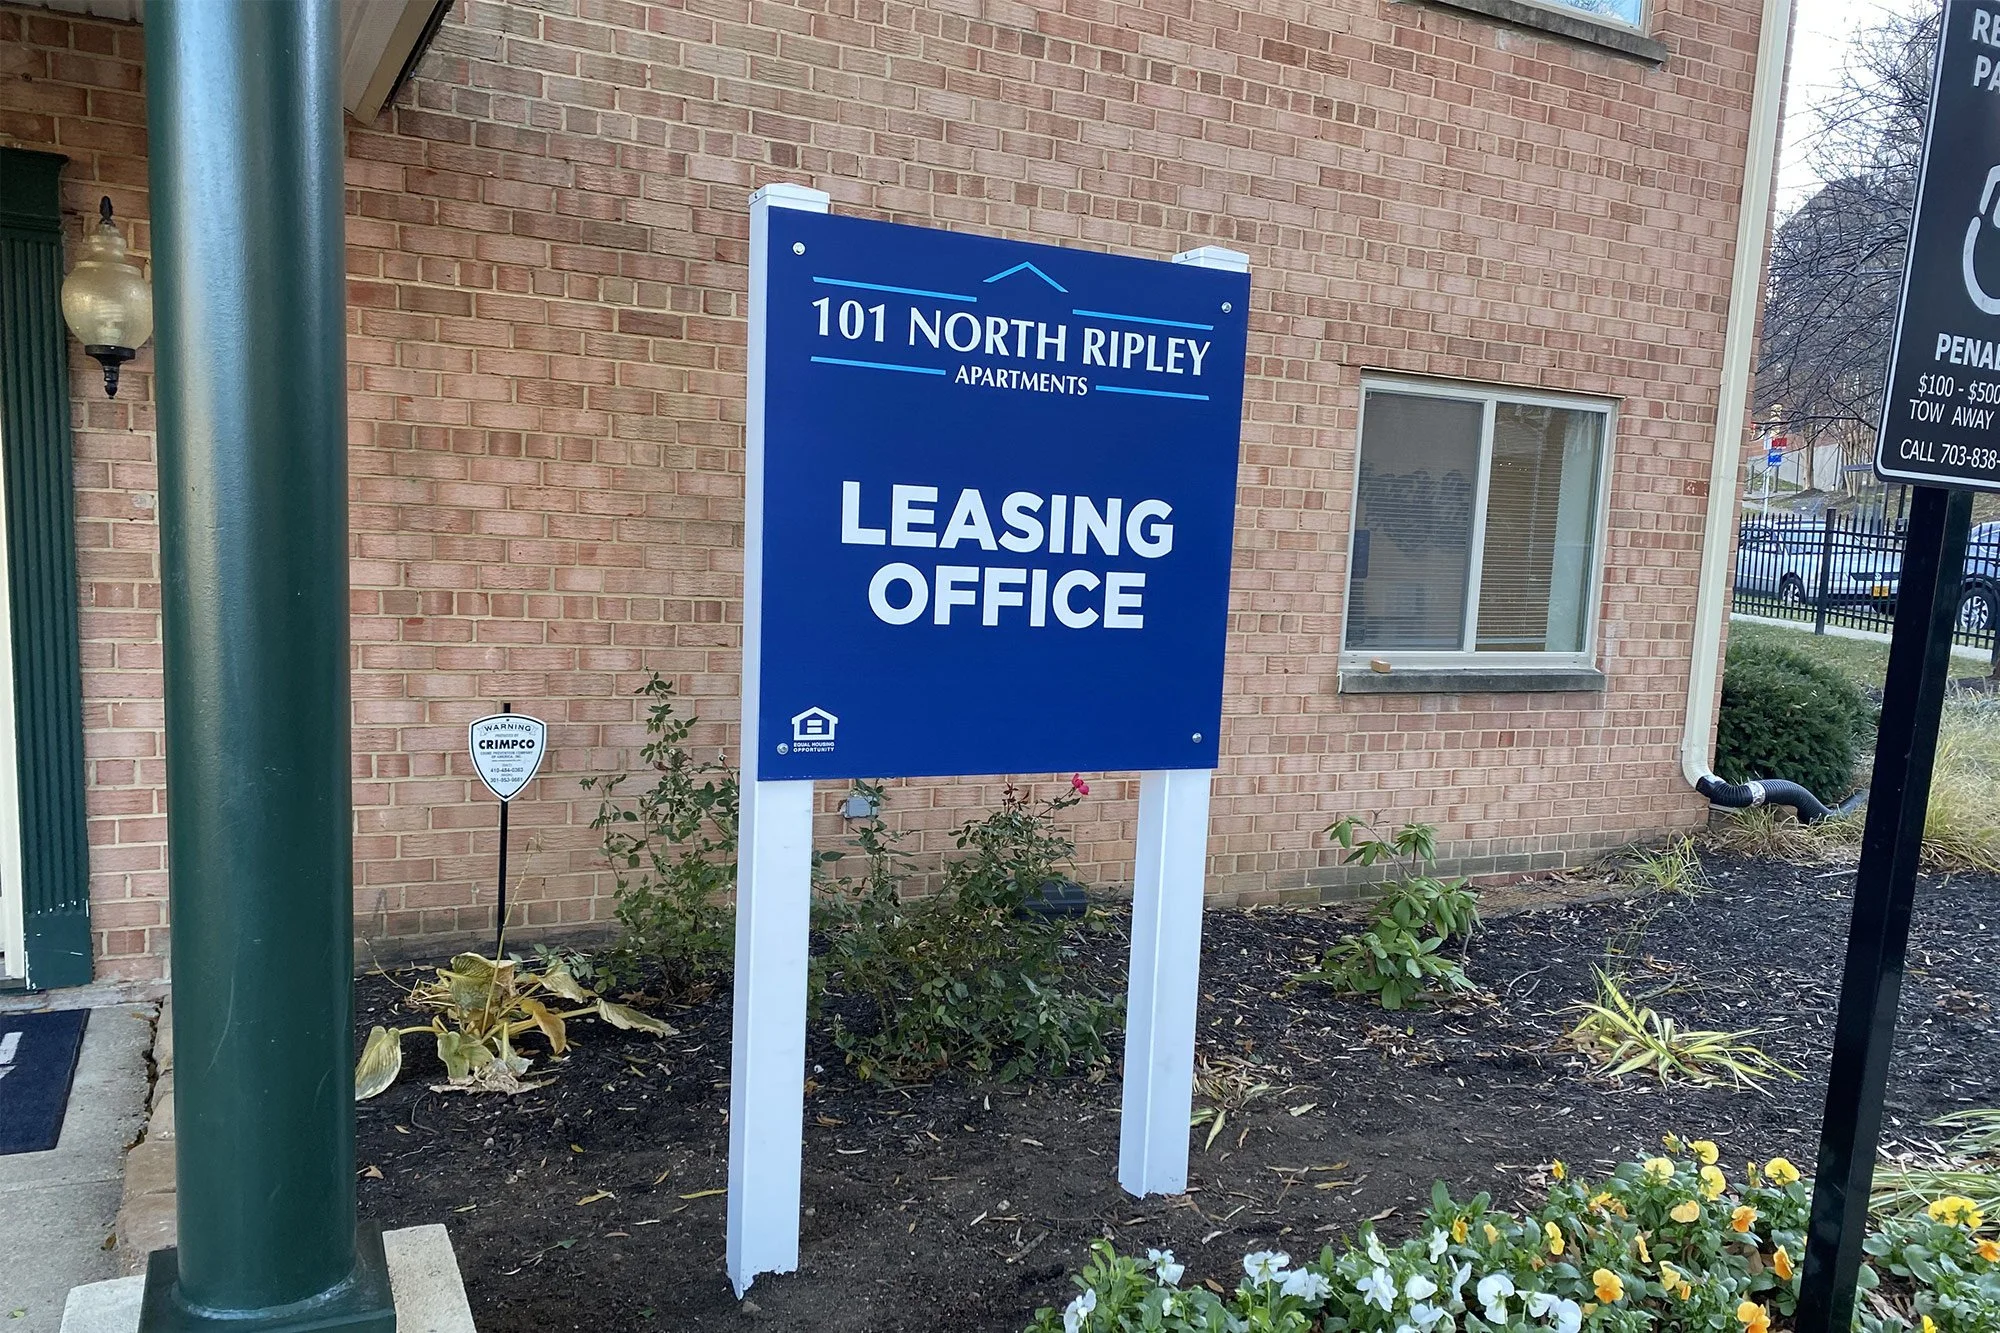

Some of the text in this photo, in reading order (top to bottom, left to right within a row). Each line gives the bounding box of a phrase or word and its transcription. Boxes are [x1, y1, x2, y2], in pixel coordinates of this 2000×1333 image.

[1972, 8, 2000, 48] RE
[812, 297, 1211, 376] 101 NORTH RIPLEY
[954, 364, 1088, 396] APARTMENTS
[1918, 372, 1954, 397] $100
[1968, 379, 2000, 405] $500
[1909, 399, 1995, 430] TOW AWAY
[1900, 438, 1935, 463] CALL
[841, 480, 1174, 559] LEASING
[868, 562, 1147, 629] OFFICE
[484, 723, 531, 732] WARNING
[479, 739, 535, 750] CRIMPCO
